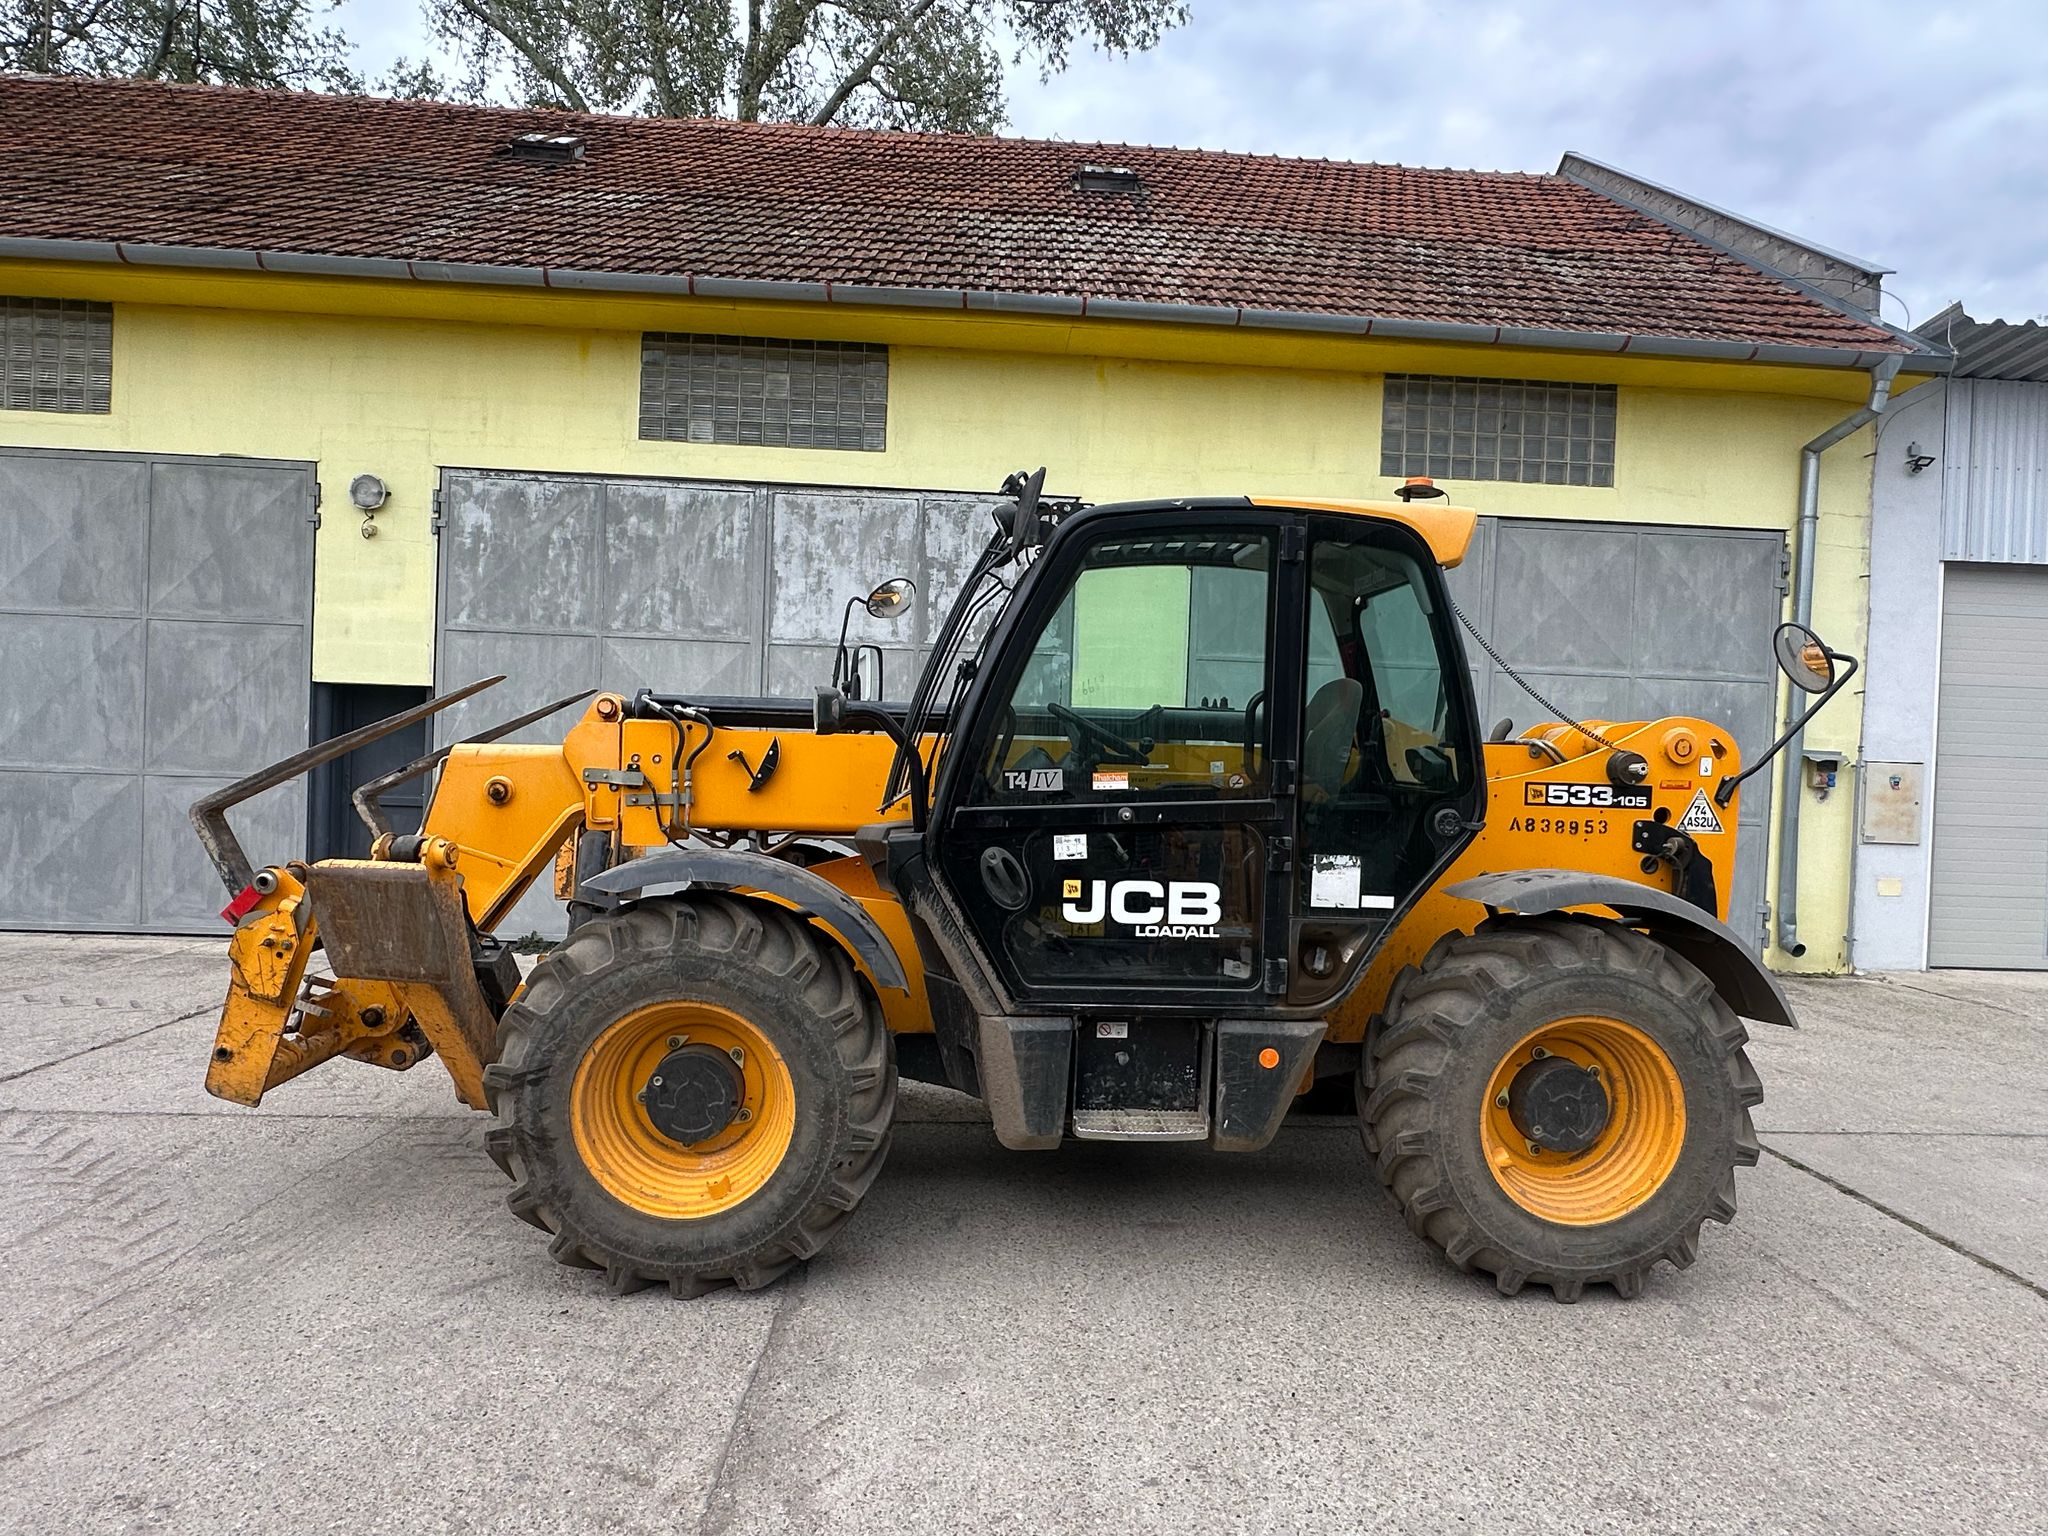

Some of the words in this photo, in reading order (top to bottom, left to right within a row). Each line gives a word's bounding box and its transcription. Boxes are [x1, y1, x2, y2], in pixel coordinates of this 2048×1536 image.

[1004, 771, 1028, 789] T4
[1033, 771, 1059, 789] IV
[1694, 805, 1707, 816] 74
[1509, 817, 1608, 835] A838953
[1687, 816, 1714, 828] AS2U
[1062, 880, 1222, 926] JCB
[1135, 925, 1220, 940] LOADALL
